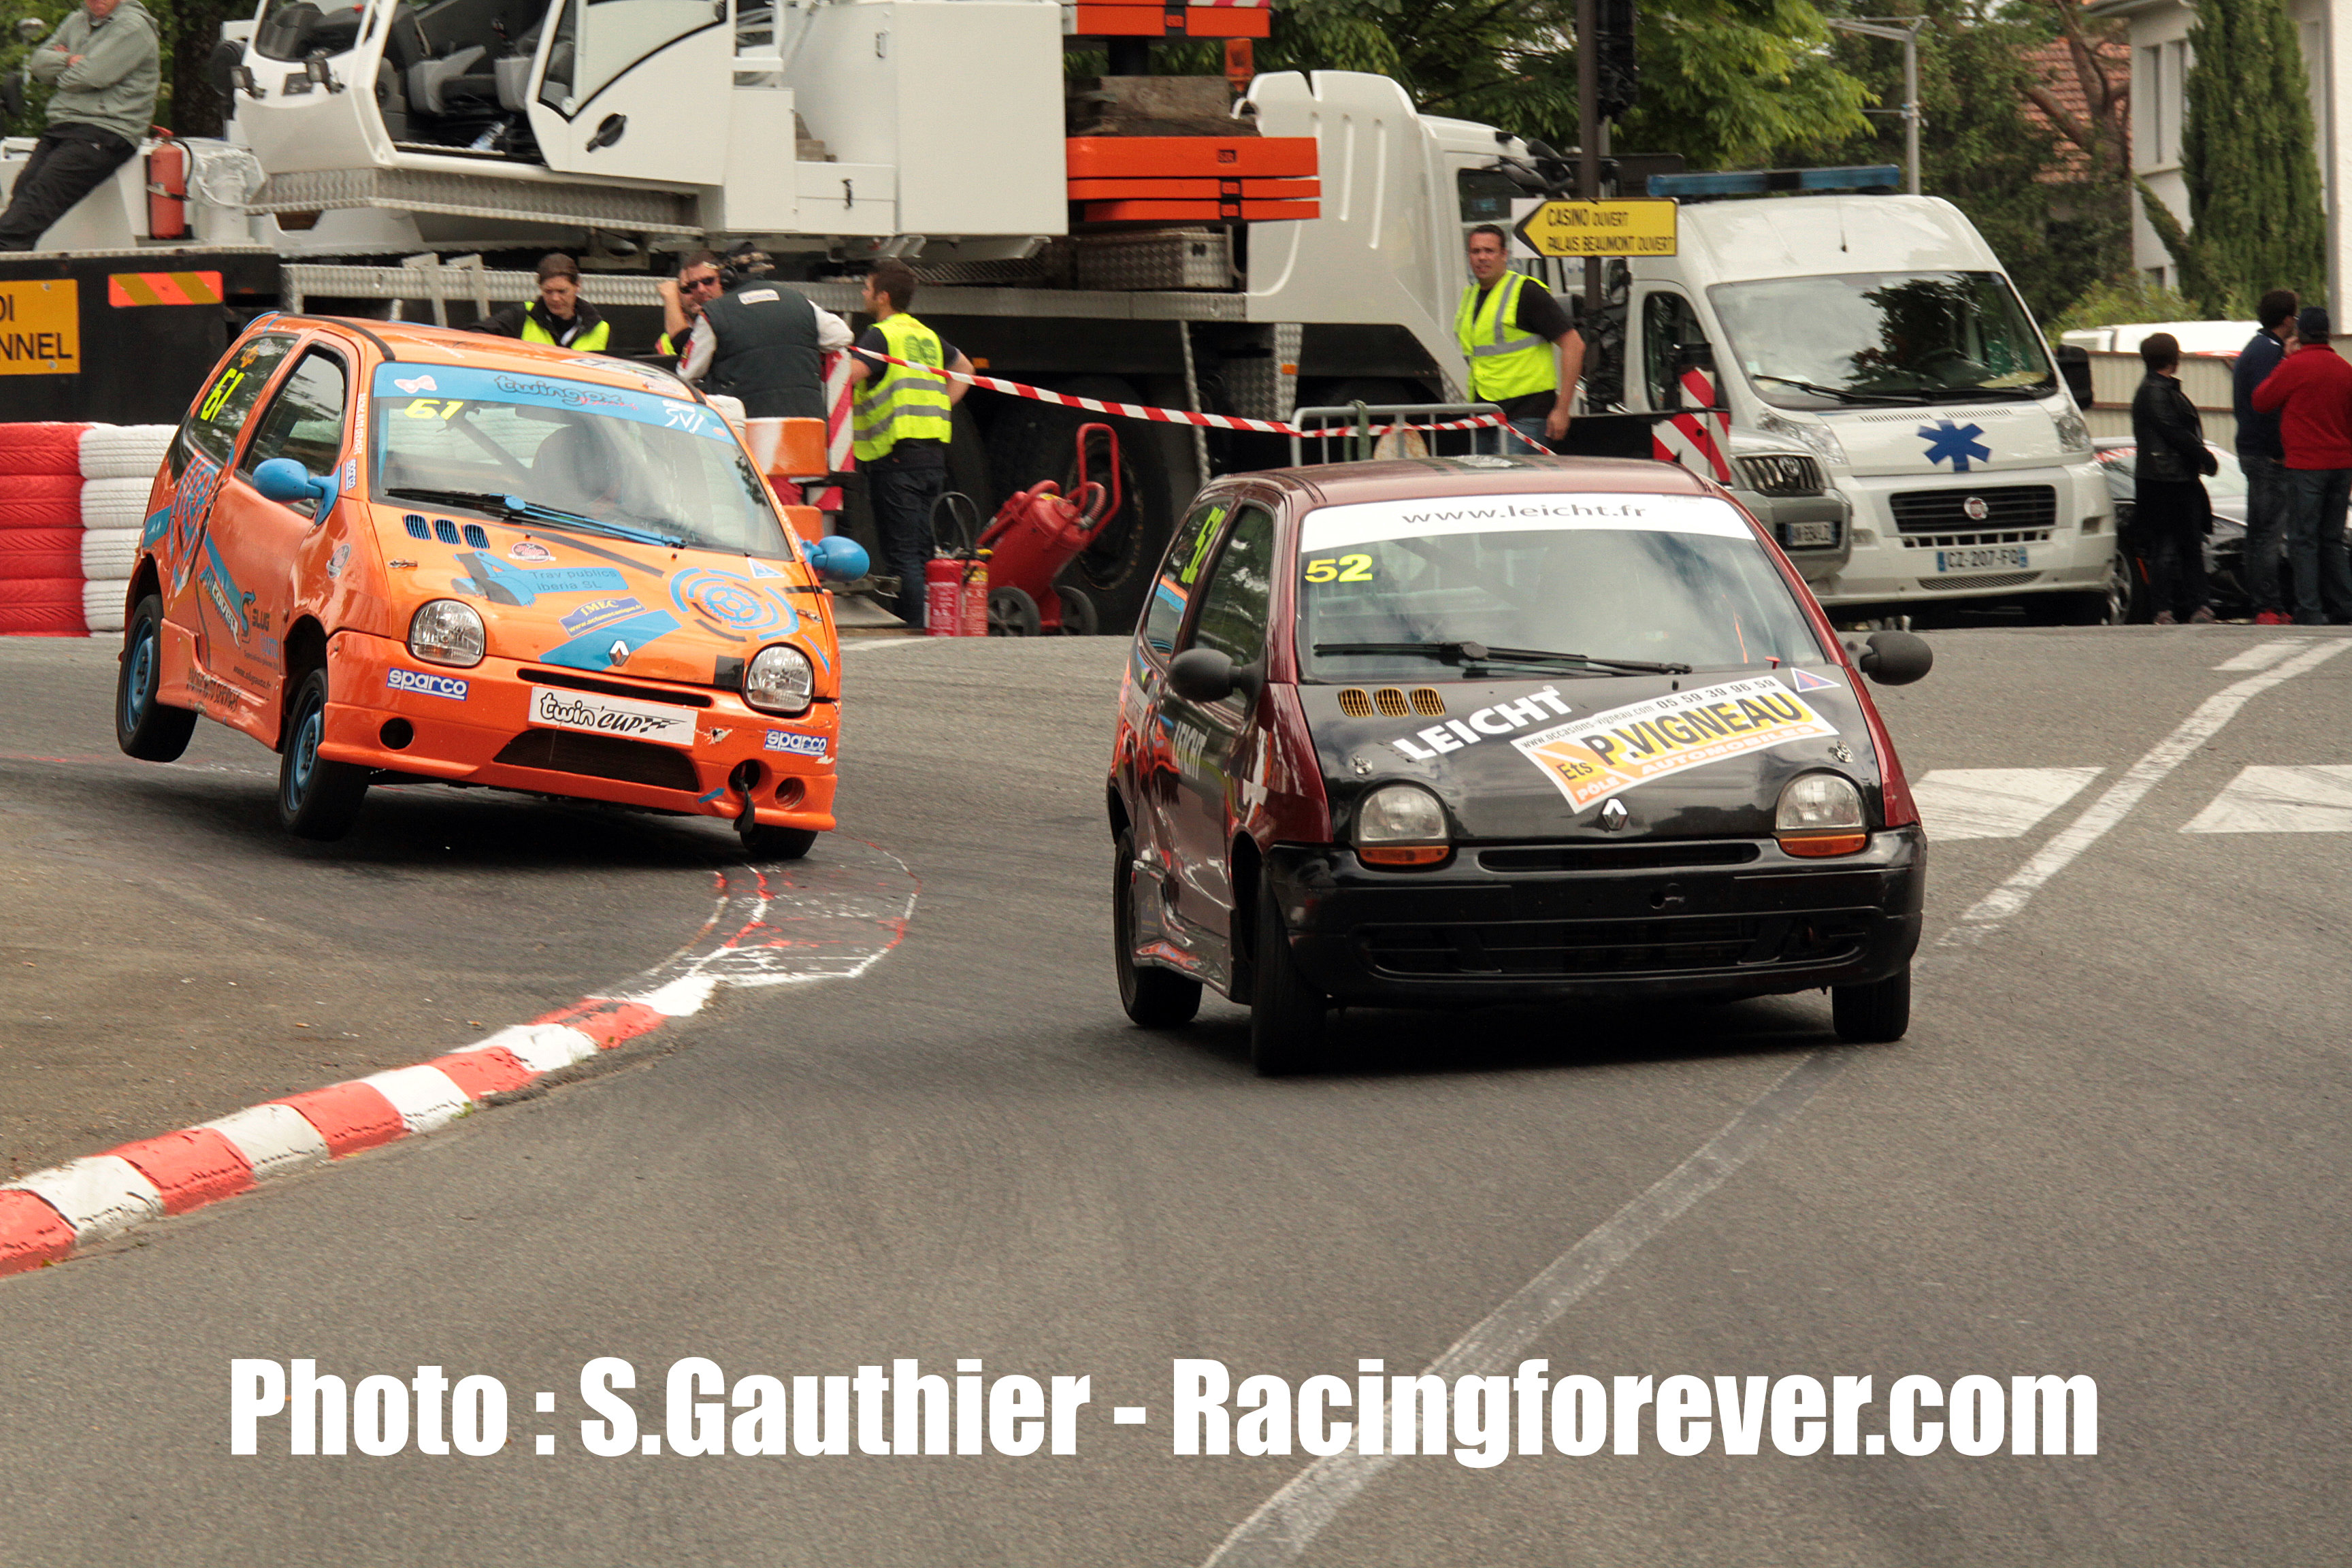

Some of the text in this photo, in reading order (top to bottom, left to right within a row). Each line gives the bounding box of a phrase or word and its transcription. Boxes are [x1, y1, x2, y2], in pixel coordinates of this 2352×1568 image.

[1547, 208, 1629, 227] CASINO OUVERT
[1547, 235, 1675, 252] PALAIS BEAUMONT OUVERT
[200, 368, 245, 423] 61
[404, 398, 464, 420] 61
[345, 458, 357, 491] sparco
[1401, 504, 1647, 525] www.leicht.fr
[529, 569, 617, 580] Trav publics
[1304, 553, 1373, 583] 52
[581, 581, 602, 589] SL
[580, 600, 619, 617] IMEC
[388, 668, 468, 698] sparco
[1656, 699, 1678, 709] 05
[1680, 693, 1703, 703] 59
[1705, 687, 1727, 698] 39
[1729, 683, 1751, 693] 96
[1754, 679, 1776, 689] 59
[1392, 687, 1572, 760] LEICHT
[1556, 691, 1803, 781] Ets P.VIGNEAU
[766, 731, 828, 755] sparco
[1576, 725, 1816, 801] PÔLE AUTOMOBILES
